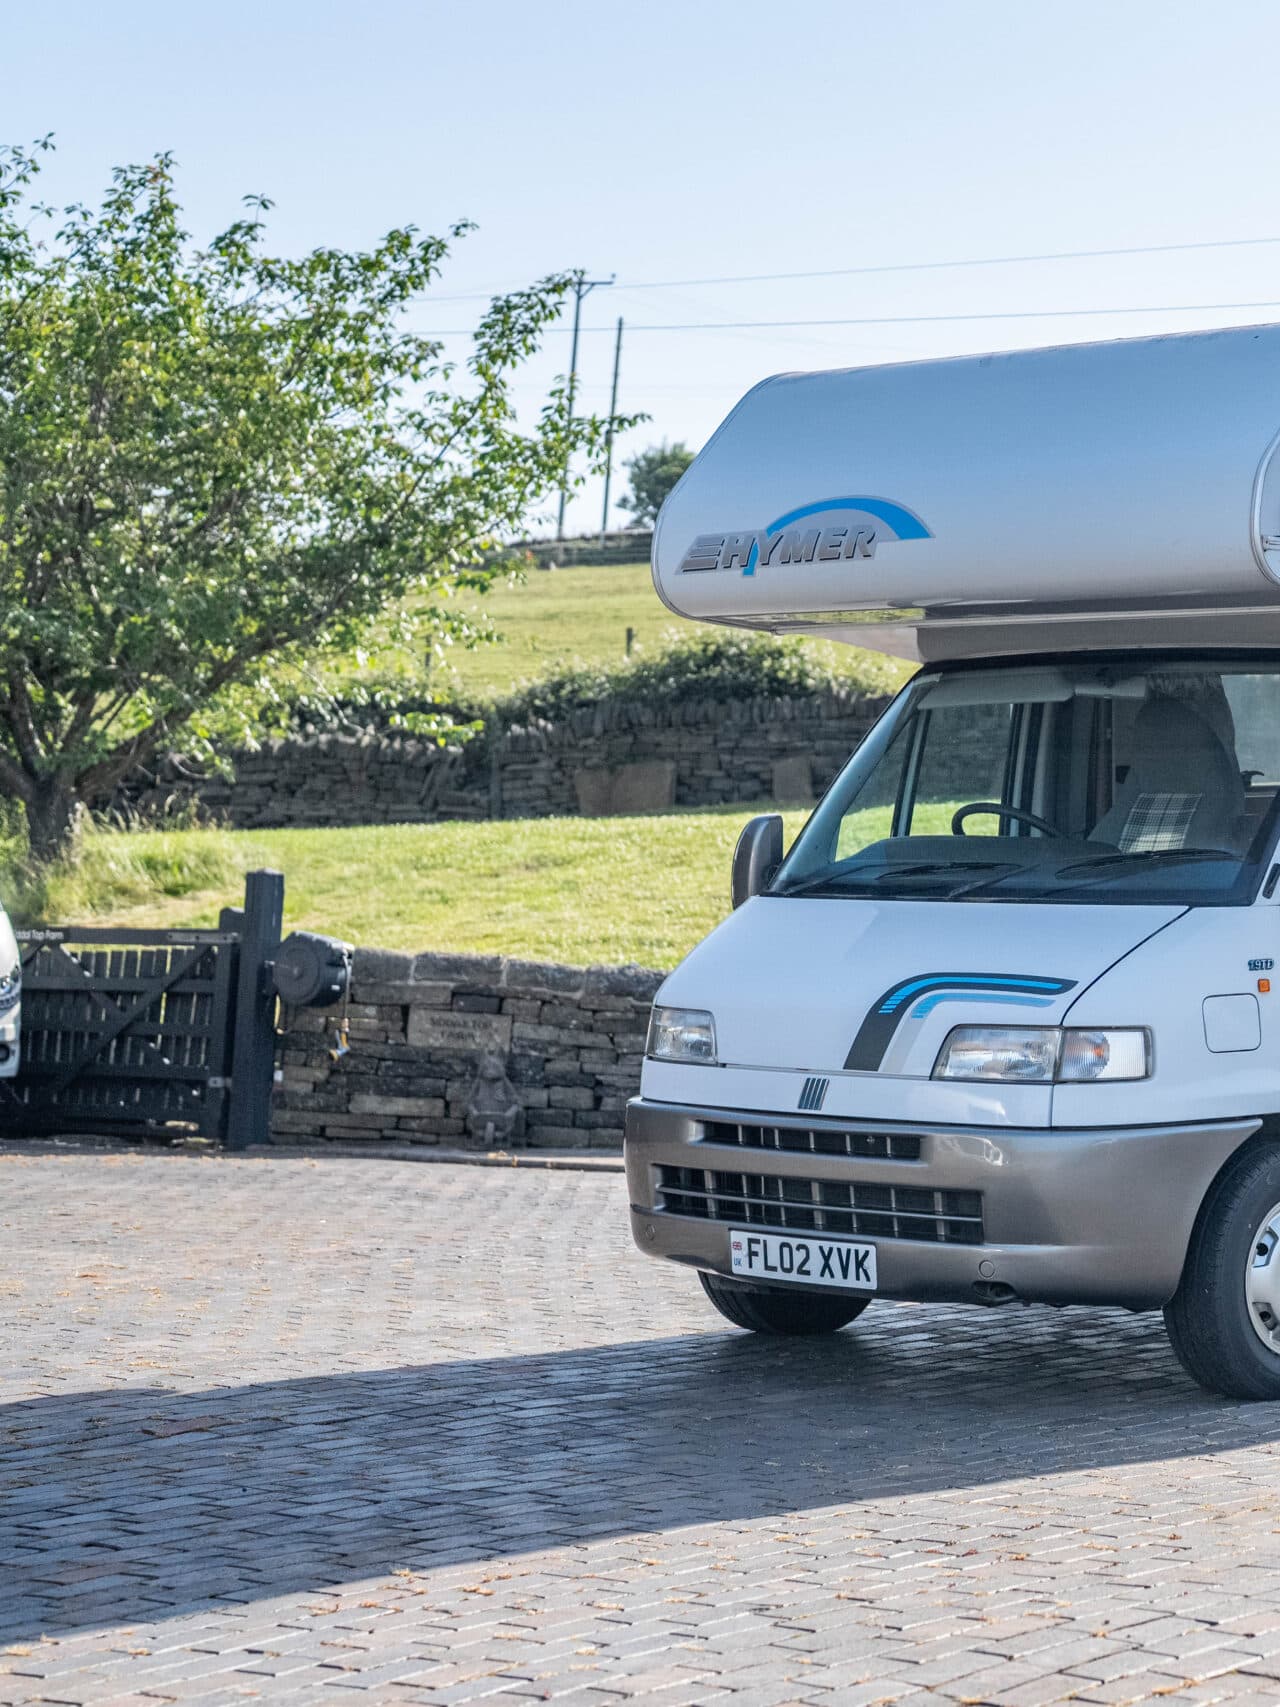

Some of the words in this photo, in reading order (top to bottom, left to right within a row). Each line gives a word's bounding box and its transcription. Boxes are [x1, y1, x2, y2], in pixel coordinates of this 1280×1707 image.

[720, 526, 876, 570] HYMER
[747, 1237, 812, 1277] FL02
[818, 1245, 871, 1283] XVK
